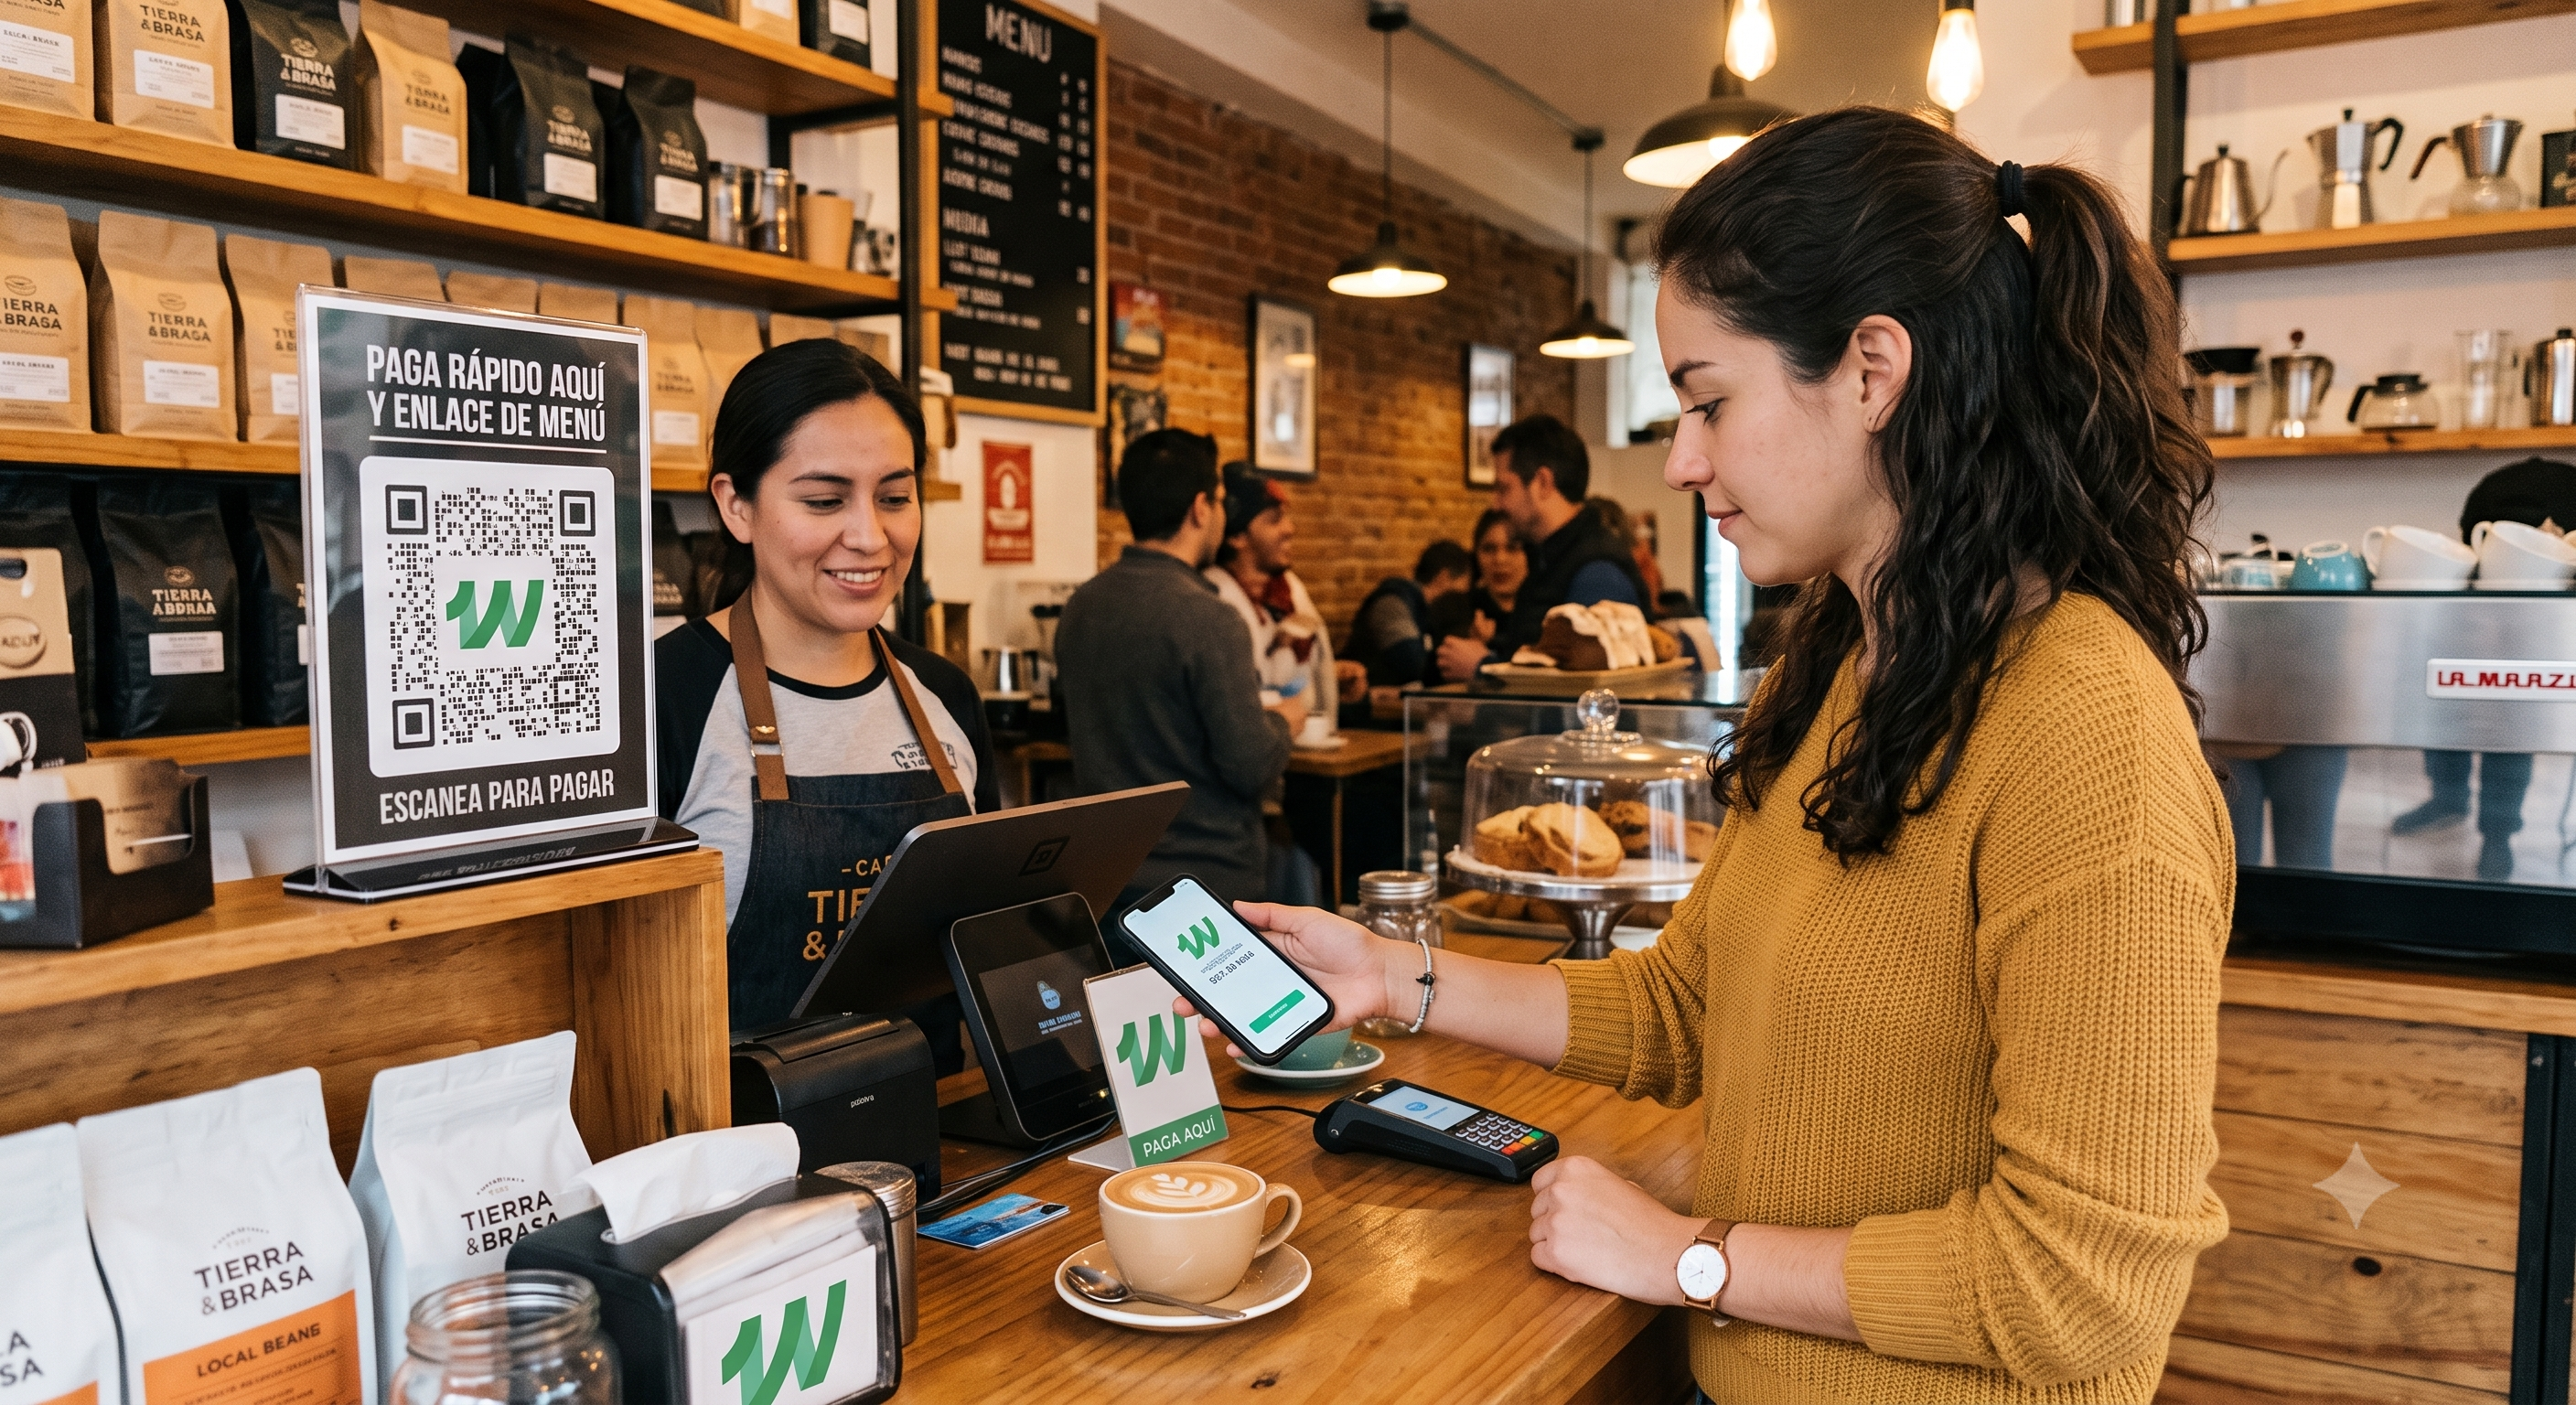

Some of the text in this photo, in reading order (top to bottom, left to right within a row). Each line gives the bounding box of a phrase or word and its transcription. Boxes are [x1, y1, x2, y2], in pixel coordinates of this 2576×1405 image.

[140, 5, 201, 27] TIERRA
[985, 3, 1052, 63] MENU
[367, 345, 442, 388] PAGA
[449, 349, 542, 395] RÁPIDO
[550, 361, 606, 402] AQUÍ
[367, 391, 606, 442] Y ENLACE DE MENÚ
[152, 588, 213, 602] TIERRA
[380, 768, 615, 824] ESCANEA PARA PAGAR
[1143, 1114, 1216, 1158] PAGA AQUÍ
[461, 1190, 553, 1231] TIERRA
[194, 1241, 304, 1288] TIERRA
[220, 1265, 314, 1310] BRASA
[197, 1347, 258, 1378] LOCAL
